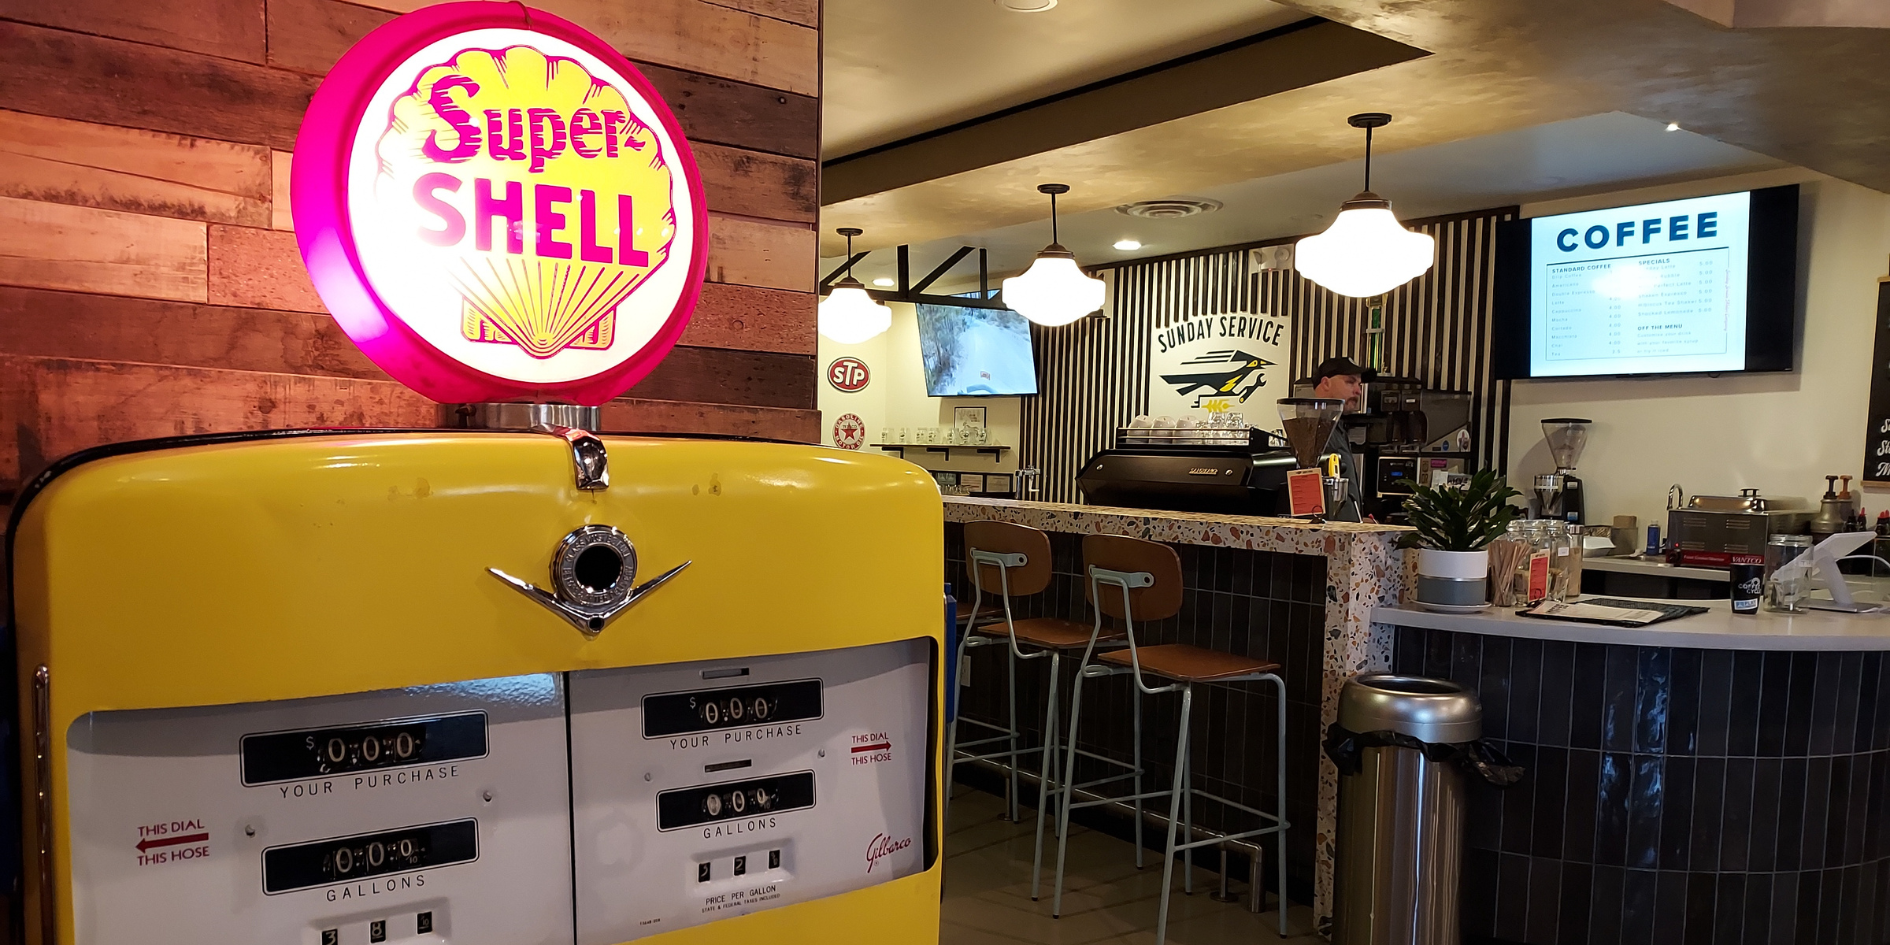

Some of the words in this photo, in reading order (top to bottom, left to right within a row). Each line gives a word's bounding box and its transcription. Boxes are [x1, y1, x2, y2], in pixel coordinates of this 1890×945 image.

[412, 171, 649, 268] SHELL
[1557, 212, 1718, 252] COFFEE
[1552, 266, 1585, 274] STANDARD
[1638, 258, 1670, 266] SPECIALS
[1158, 317, 1214, 353] SUNDAY
[1219, 315, 1285, 347] SERVICE
[833, 361, 865, 386] STP
[836, 414, 863, 428] GASOLINE
[689, 697, 696, 709] $
[306, 736, 314, 750] $
[670, 735, 709, 750] YOUR
[724, 725, 802, 744] PURCHASE
[852, 734, 869, 744] THIS
[870, 731, 889, 741] DIAL
[851, 755, 868, 765] THIS
[870, 752, 892, 763] HOSE
[279, 781, 333, 799] YOUR
[354, 765, 460, 790] PURCHASE
[137, 823, 167, 837] THIS
[171, 819, 205, 832] DIAL
[703, 818, 777, 839] GALLONS
[137, 852, 167, 866] THIS
[171, 846, 210, 861] HOSE
[866, 832, 911, 874] Gilbarco
[326, 874, 425, 902] GALLONS
[705, 895, 726, 905] PRICE
[731, 891, 744, 900] PER
[749, 885, 776, 896] GALLON
[723, 901, 742, 909] FEDERAL
[759, 893, 780, 902] INCLUDED
